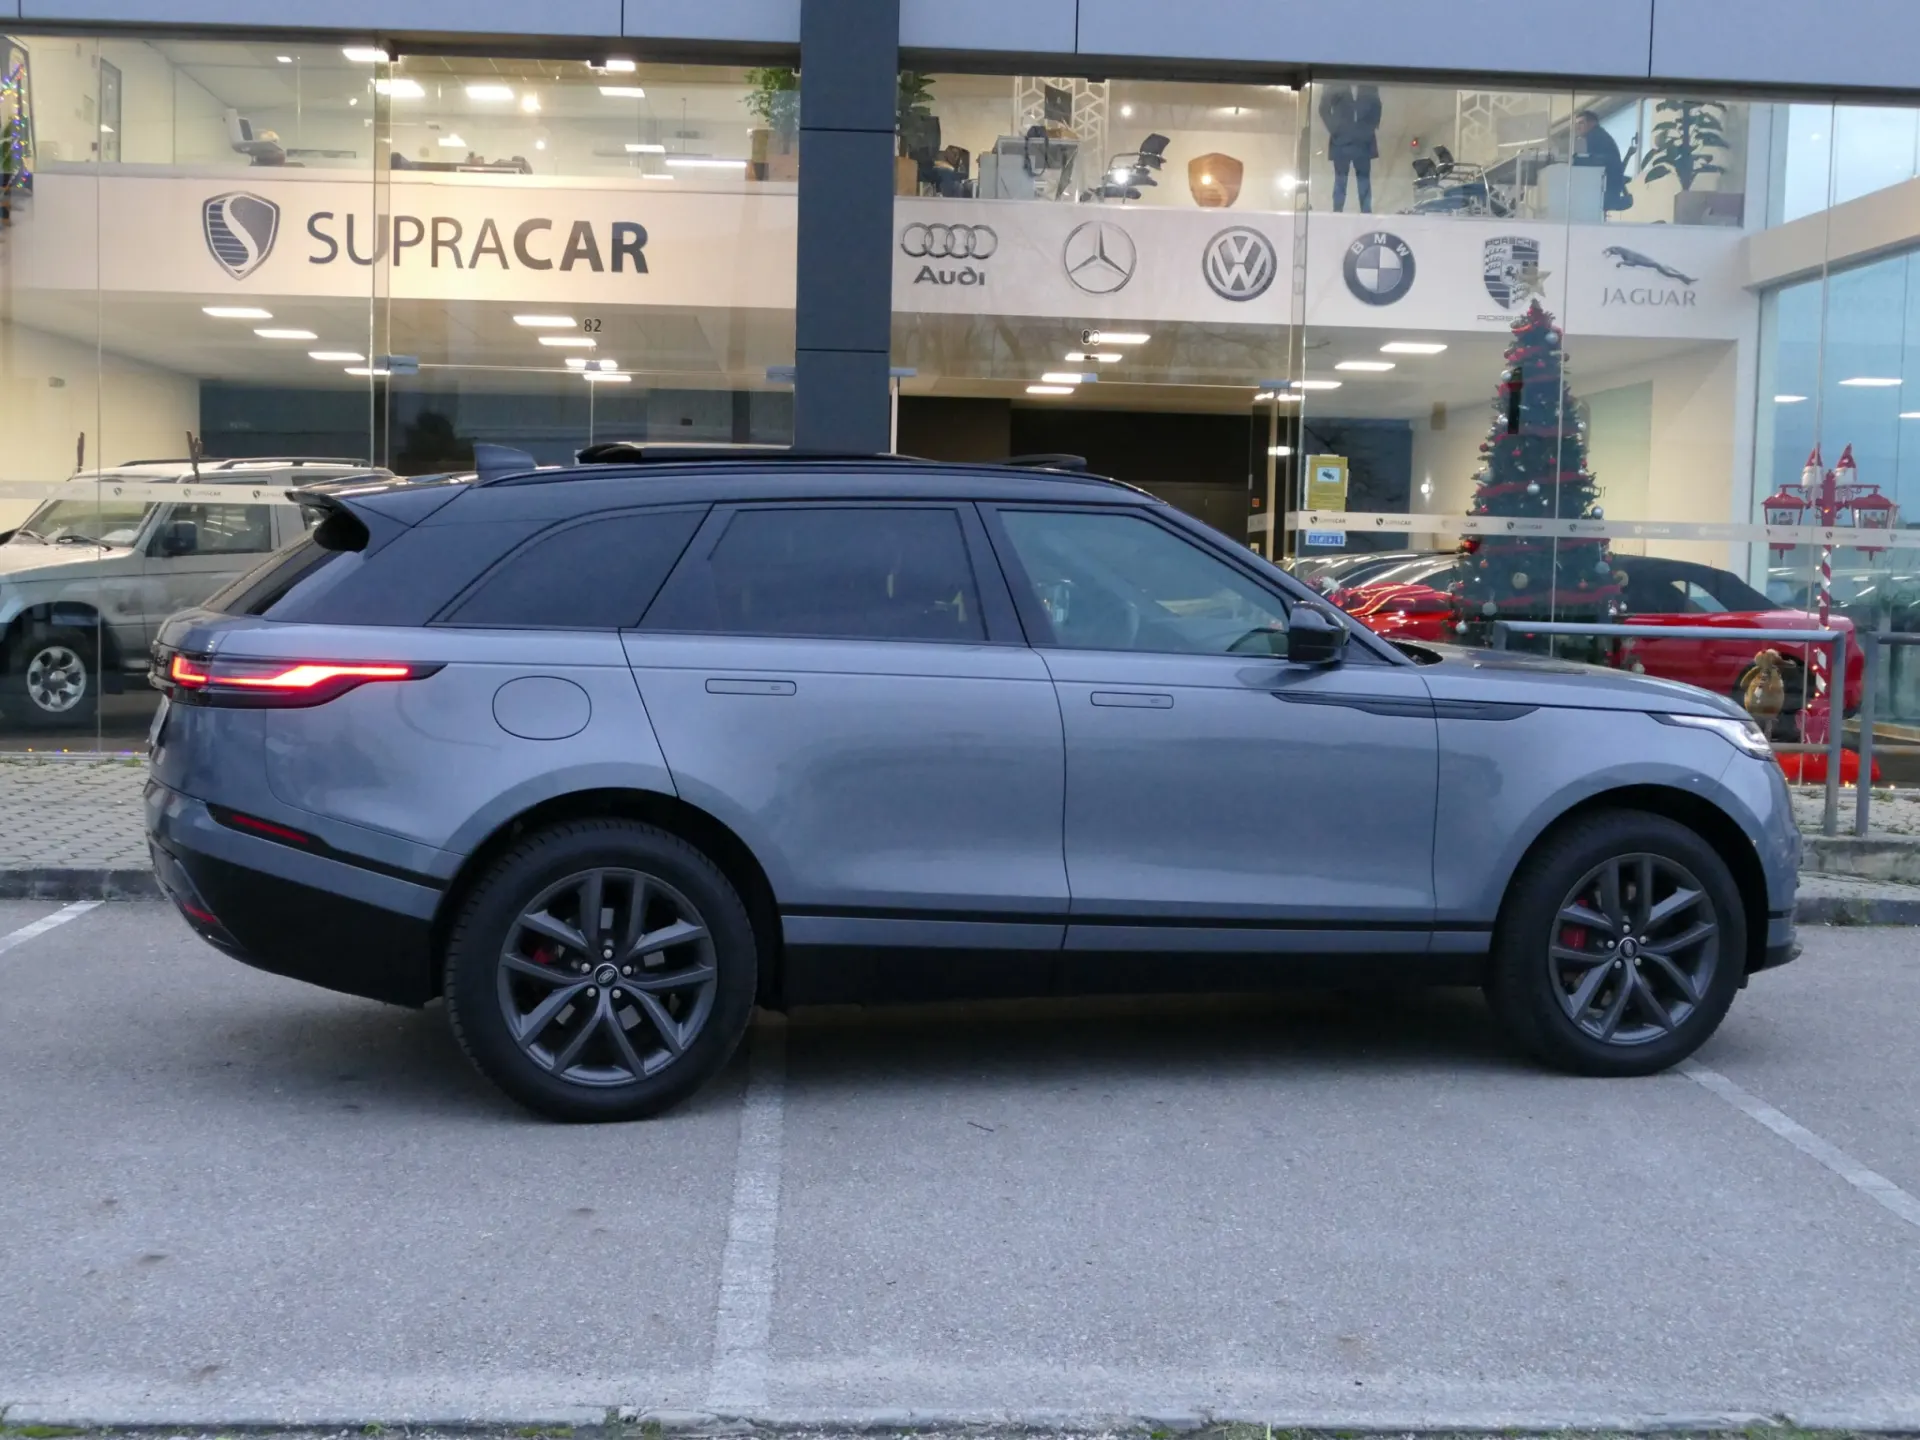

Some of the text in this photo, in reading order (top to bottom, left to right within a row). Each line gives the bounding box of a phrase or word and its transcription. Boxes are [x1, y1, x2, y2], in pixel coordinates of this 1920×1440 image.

[307, 211, 649, 274] SUPRACAR
[1351, 233, 1410, 257] BMW
[913, 265, 985, 286] Audi
[1602, 287, 1696, 307] JAGUAR
[584, 318, 602, 333] 82
